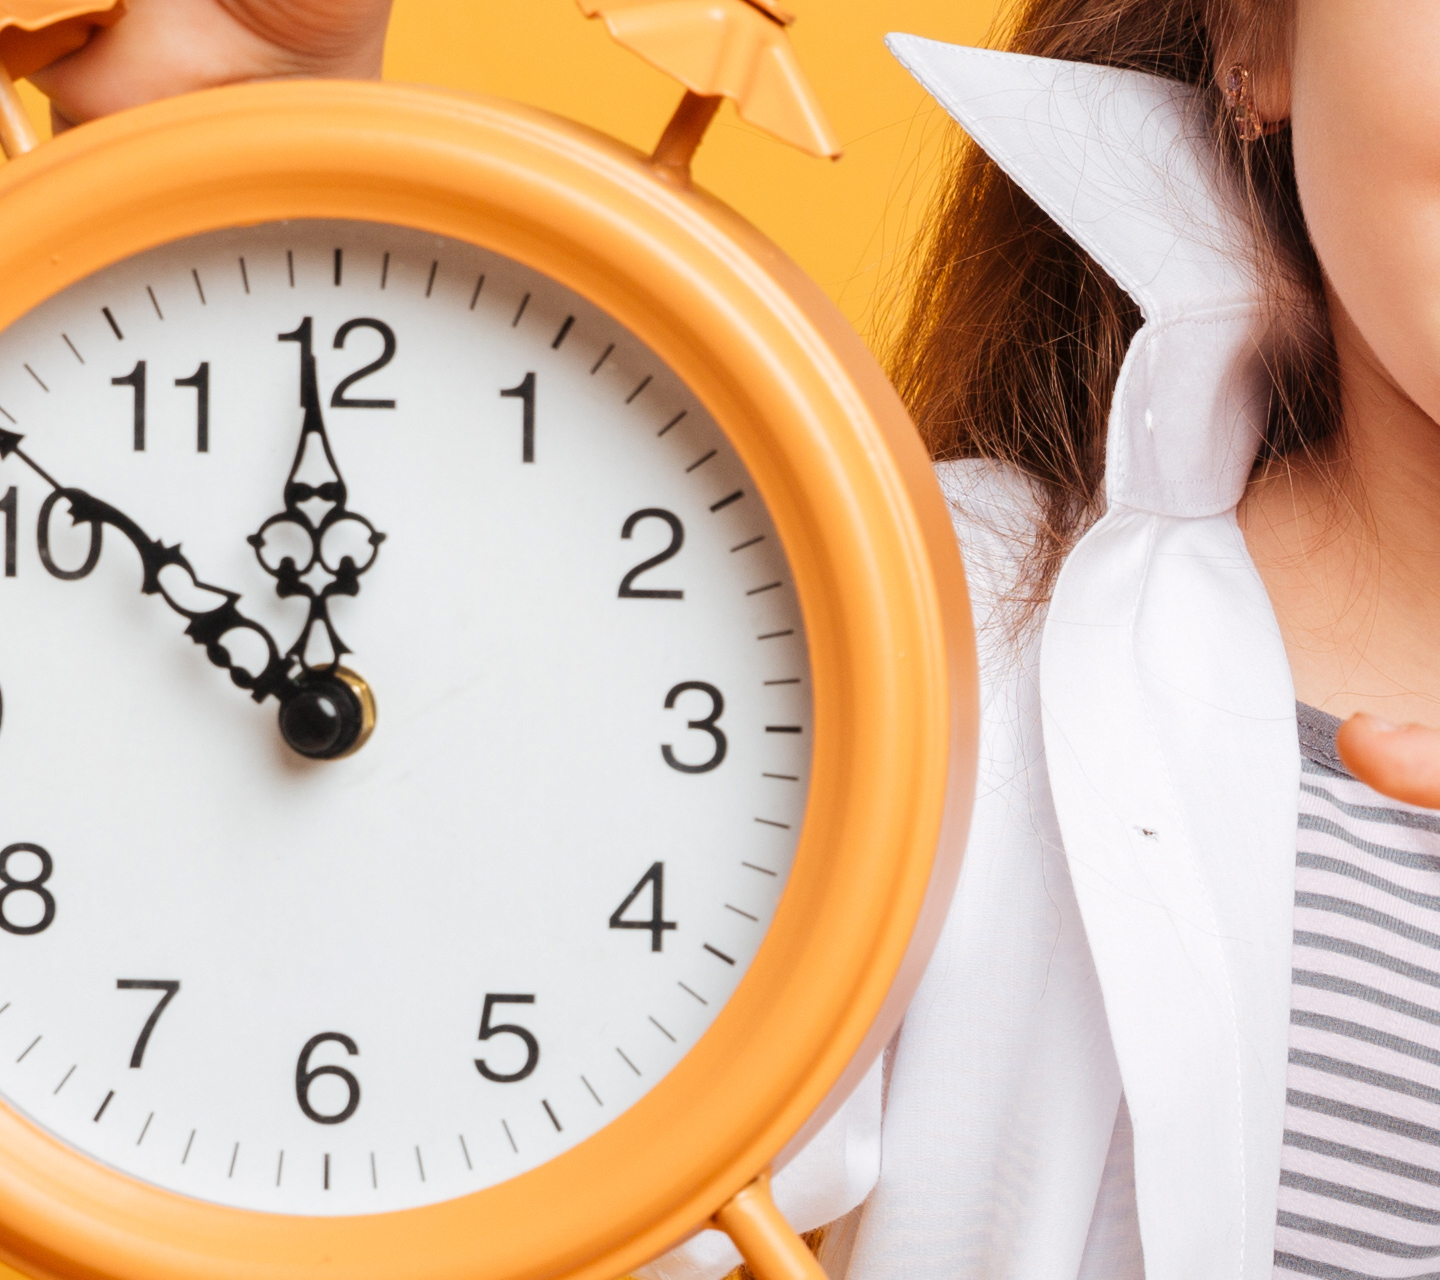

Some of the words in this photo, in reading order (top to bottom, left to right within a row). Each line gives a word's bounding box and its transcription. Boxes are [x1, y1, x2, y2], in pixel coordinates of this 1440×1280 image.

[111, 360, 210, 453] 11
[276, 316, 398, 410] 12
[500, 371, 536, 463] 1
[617, 507, 685, 600] 2
[661, 680, 728, 774] 3
[609, 861, 677, 952] 4
[116, 979, 180, 1069] 7
[474, 993, 540, 1083] 5
[295, 1031, 361, 1125] 6
